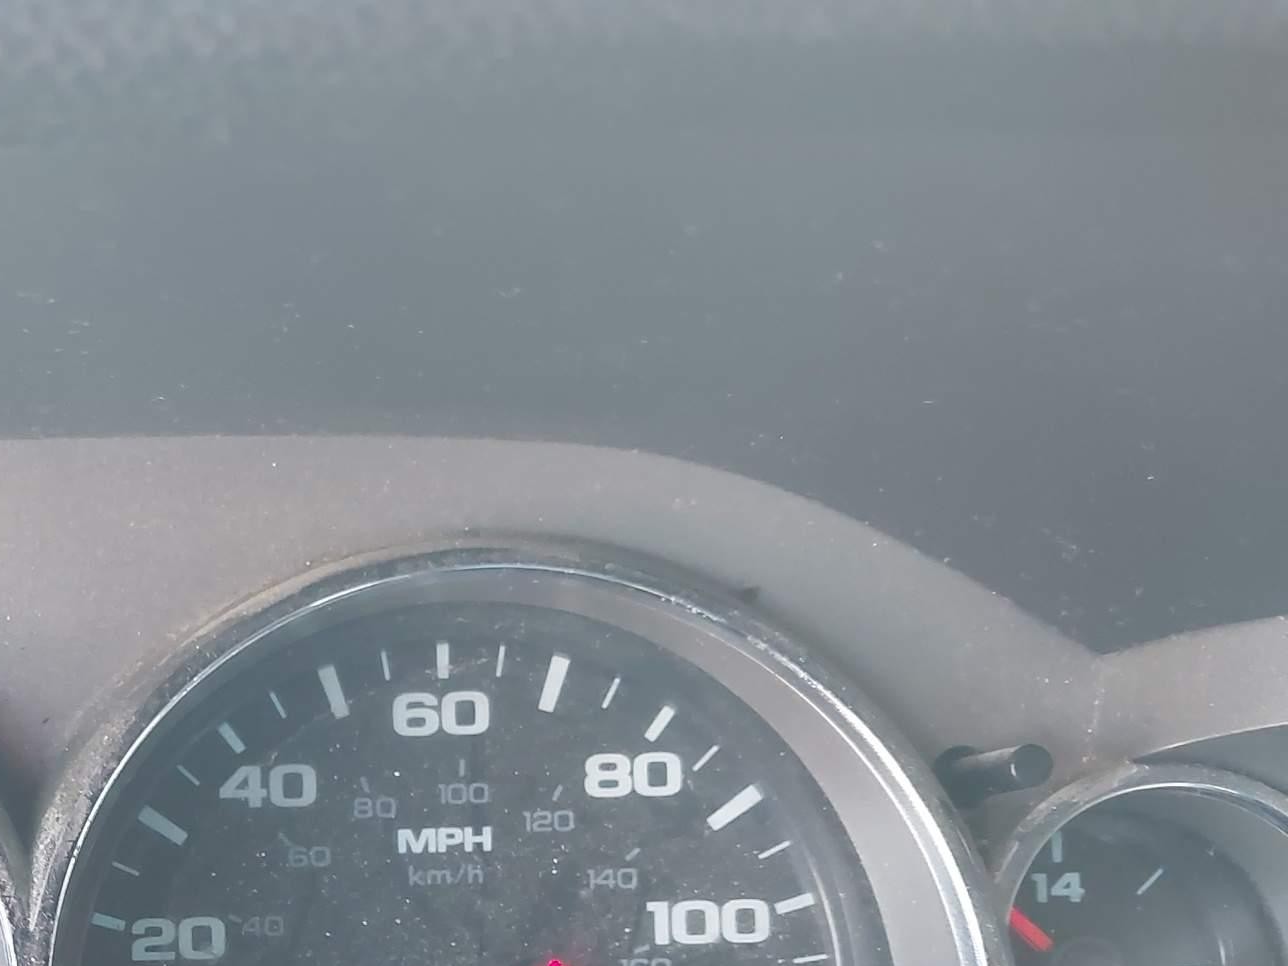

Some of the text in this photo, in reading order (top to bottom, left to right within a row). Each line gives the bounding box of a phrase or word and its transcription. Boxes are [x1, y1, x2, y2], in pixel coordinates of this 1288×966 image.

[392, 691, 490, 737] 60
[218, 764, 317, 808] 40
[584, 751, 683, 798] 80
[439, 782, 490, 806] 100
[353, 798, 397, 819] 80
[523, 809, 575, 832] 120
[397, 826, 492, 854] MPH
[288, 846, 331, 868] 60
[408, 865, 483, 886] km/h
[586, 868, 638, 890] 140
[1031, 872, 1085, 902] 14
[241, 916, 284, 936] 40
[646, 899, 770, 945] 100
[131, 916, 226, 961] 20
